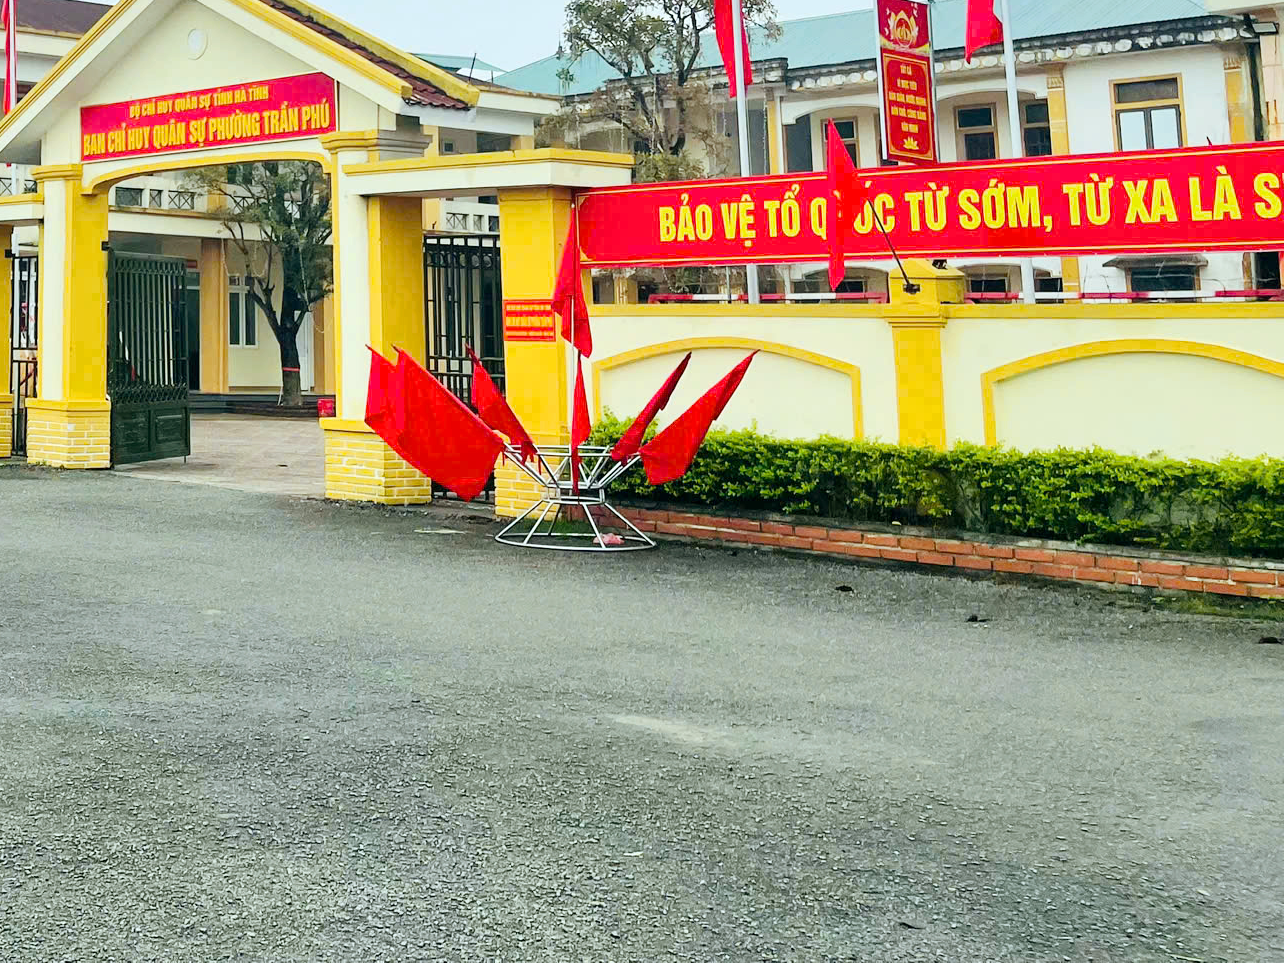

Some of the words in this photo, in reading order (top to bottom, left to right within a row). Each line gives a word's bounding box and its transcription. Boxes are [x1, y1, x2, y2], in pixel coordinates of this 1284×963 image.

[83, 132, 106, 156] BAN
[107, 122, 127, 153] CHỈ
[127, 126, 151, 151] HUY
[153, 119, 187, 150] QUÂN
[189, 117, 208, 147] SỰ
[208, 109, 261, 141] PHƯỜNG
[263, 101, 299, 135] TRẦN
[301, 98, 331, 130] PHÚ
[129, 102, 141, 120] BỘ
[141, 98, 156, 117] CHỈ
[157, 99, 173, 114] HUY
[174, 93, 198, 113] QUÂN
[198, 93, 212, 110] SỰ
[234, 88, 247, 104] HÀ
[658, 193, 714, 243] BẢO
[721, 194, 757, 248] VỆ
[764, 183, 802, 238] TỔ
[904, 181, 950, 233] TỪ
[958, 178, 1053, 233] SỚM,
[1062, 173, 1114, 227] TỪ
[1123, 179, 1178, 224] XA
[1188, 165, 1242, 222] LÀ
[1253, 172, 1284, 219] S
